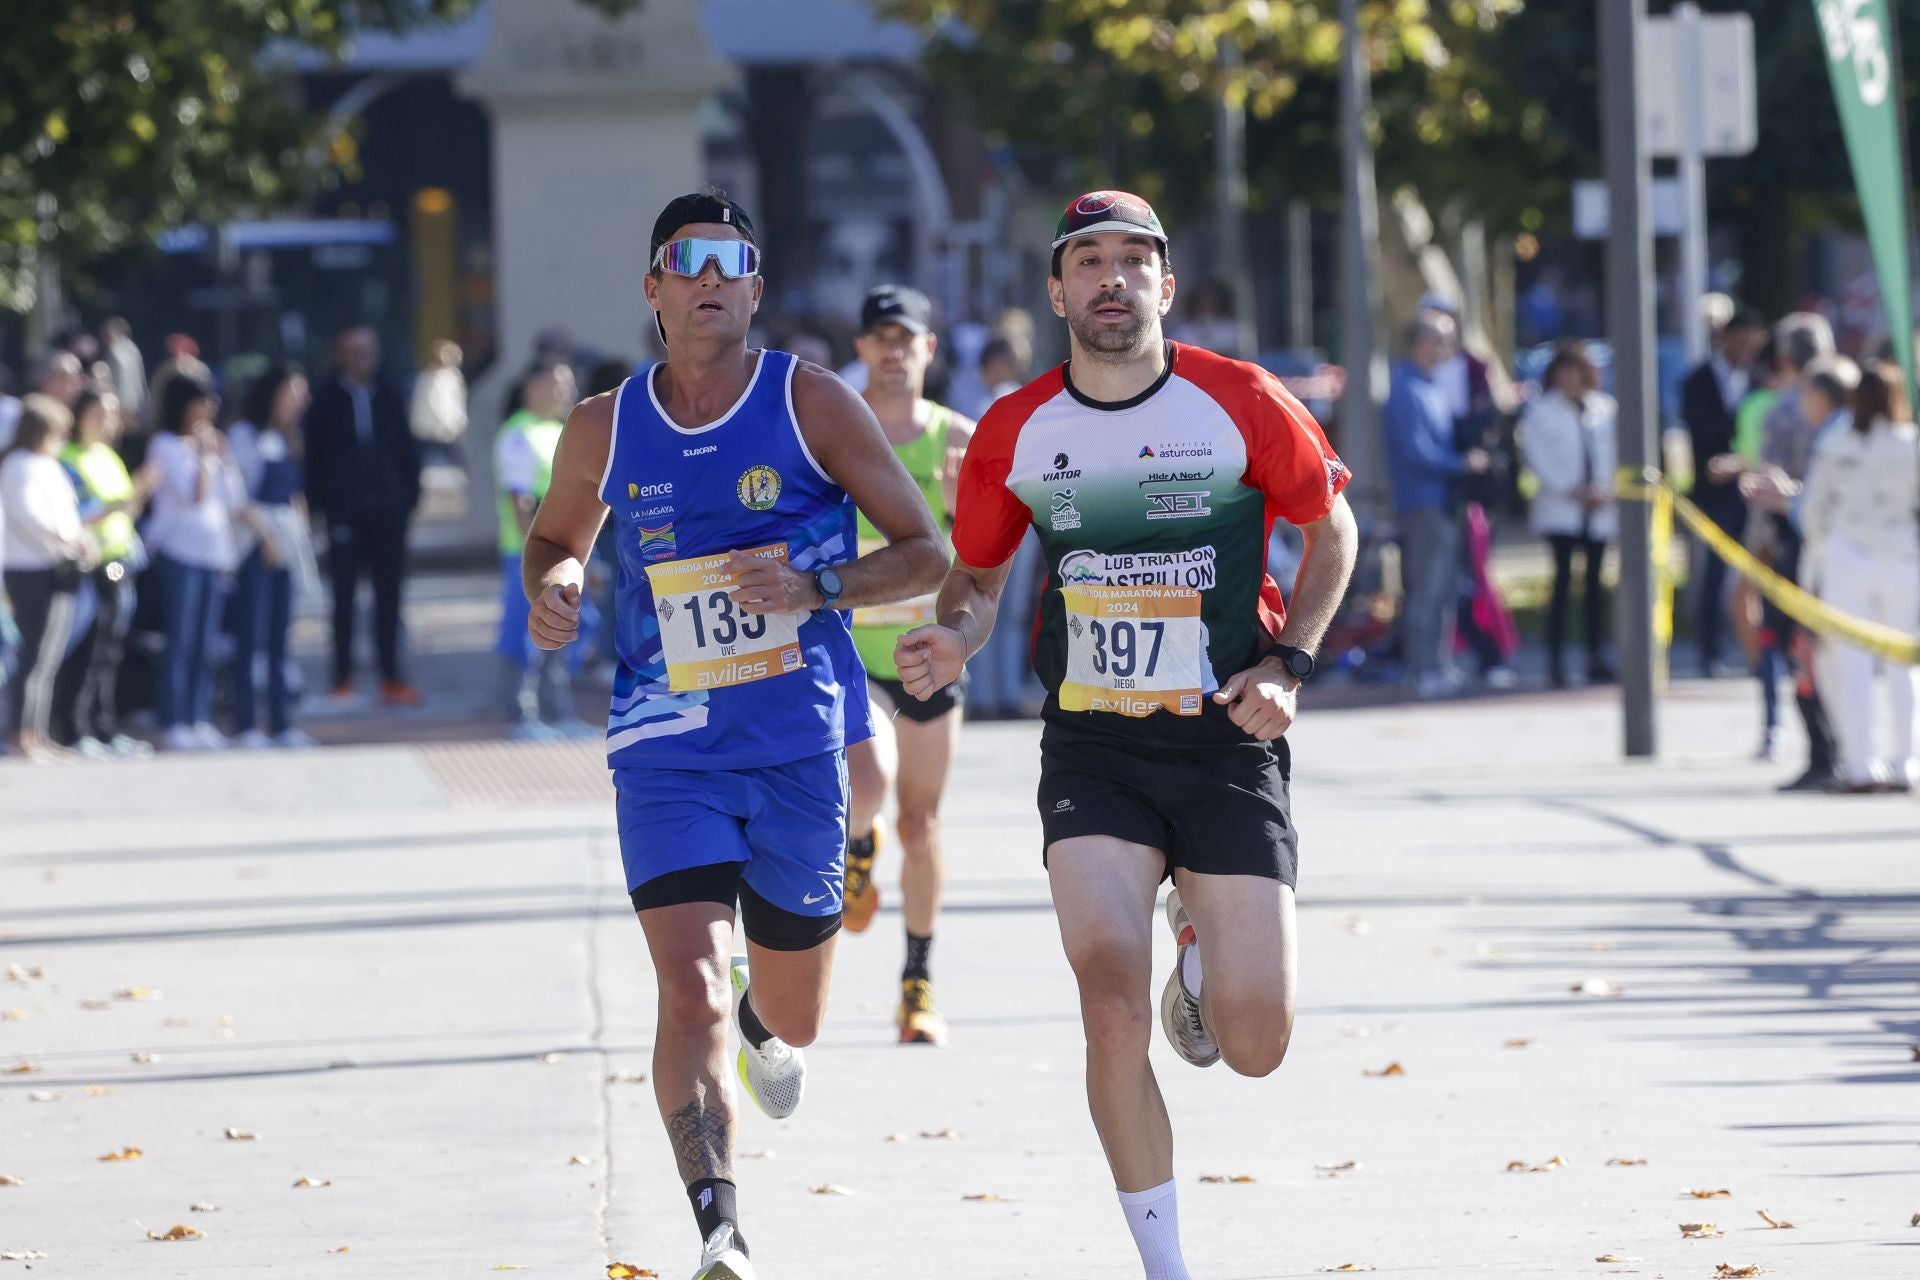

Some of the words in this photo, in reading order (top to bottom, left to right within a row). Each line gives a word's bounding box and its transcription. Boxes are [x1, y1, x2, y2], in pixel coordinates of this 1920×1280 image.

[683, 445, 717, 456] SUKAN
[1160, 448, 1212, 458] asturcopia
[1042, 469, 1082, 482] VIATOR
[640, 482, 673, 497] ence
[630, 511, 641, 519] LA
[641, 505, 675, 518] MAGAYA
[1138, 548, 1214, 567] TRIATLON
[674, 562, 703, 575] MEDIA
[701, 573, 732, 586] 2024
[1084, 589, 1109, 599] MEDIA
[1111, 587, 1161, 599] MARATÓN
[1164, 588, 1198, 598] AVILÉS
[1106, 602, 1139, 613] 2024
[721, 645, 737, 657] UVE
[1090, 619, 1165, 678] 397
[697, 661, 768, 687] avilés
[1114, 678, 1135, 689] DIEGO
[1090, 697, 1161, 714] avilés
